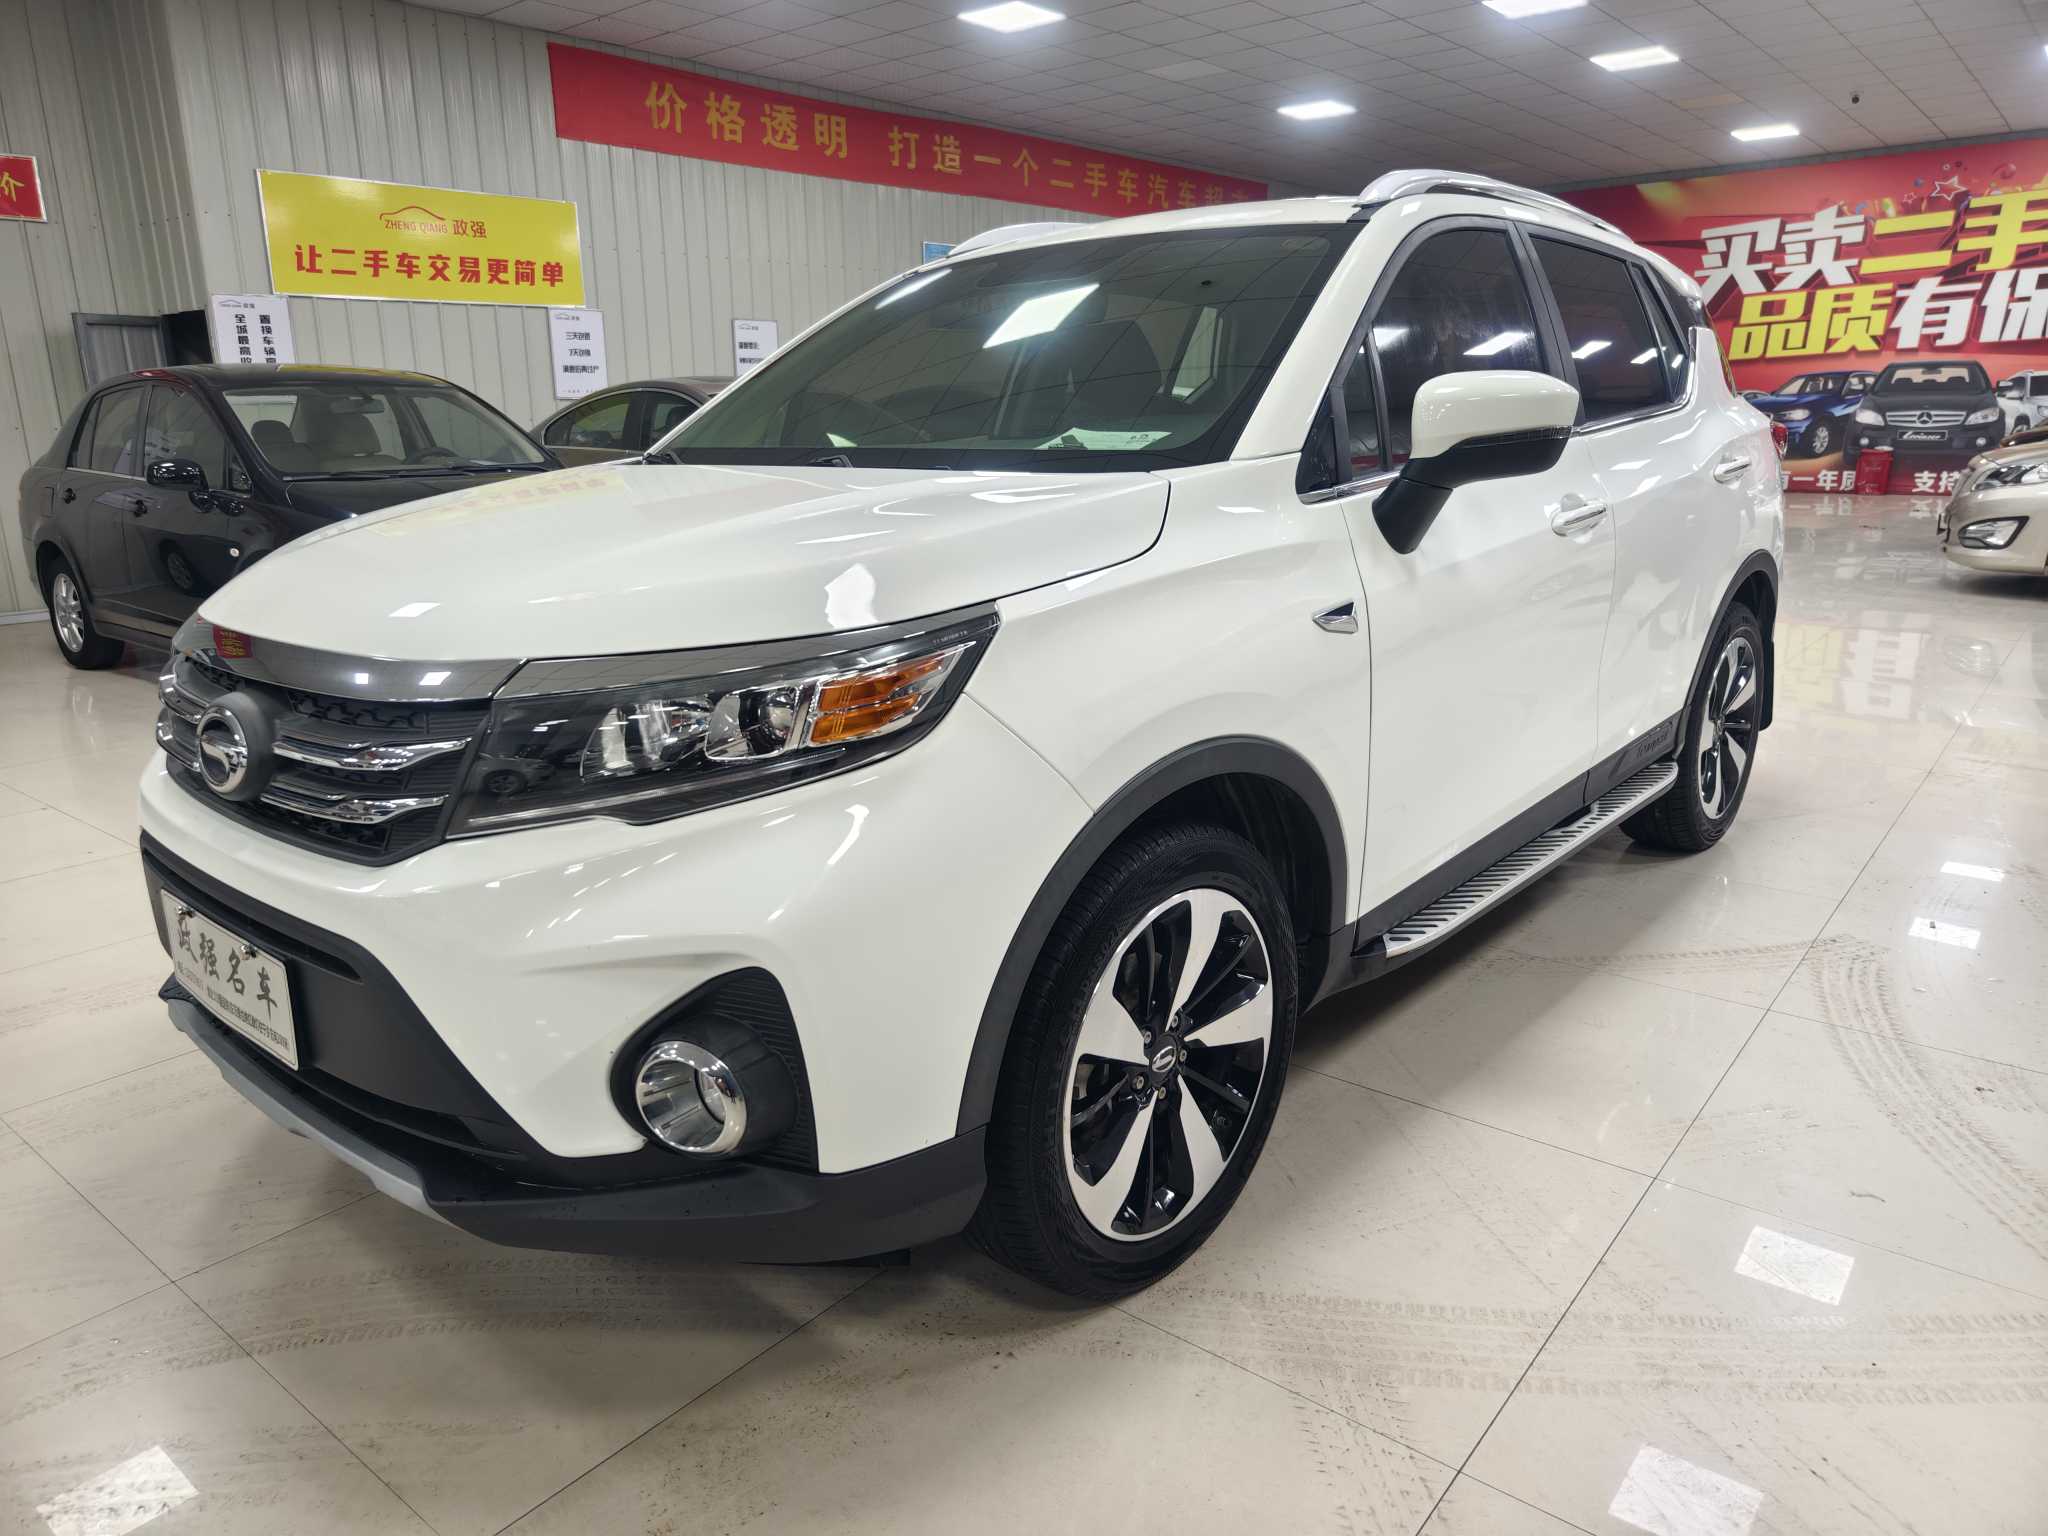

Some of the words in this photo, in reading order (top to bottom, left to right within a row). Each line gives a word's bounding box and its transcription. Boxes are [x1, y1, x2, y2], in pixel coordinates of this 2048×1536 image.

[645, 80, 848, 159] 价格透明
[384, 219, 418, 232] ZHENG
[420, 222, 448, 234] QIANG
[452, 219, 487, 239] 政强
[1694, 190, 2048, 306] 买卖二手
[294, 244, 564, 288] 让二手车交易更简单
[1728, 268, 2048, 361] 品质有保
[1911, 470, 1961, 494] 支持
